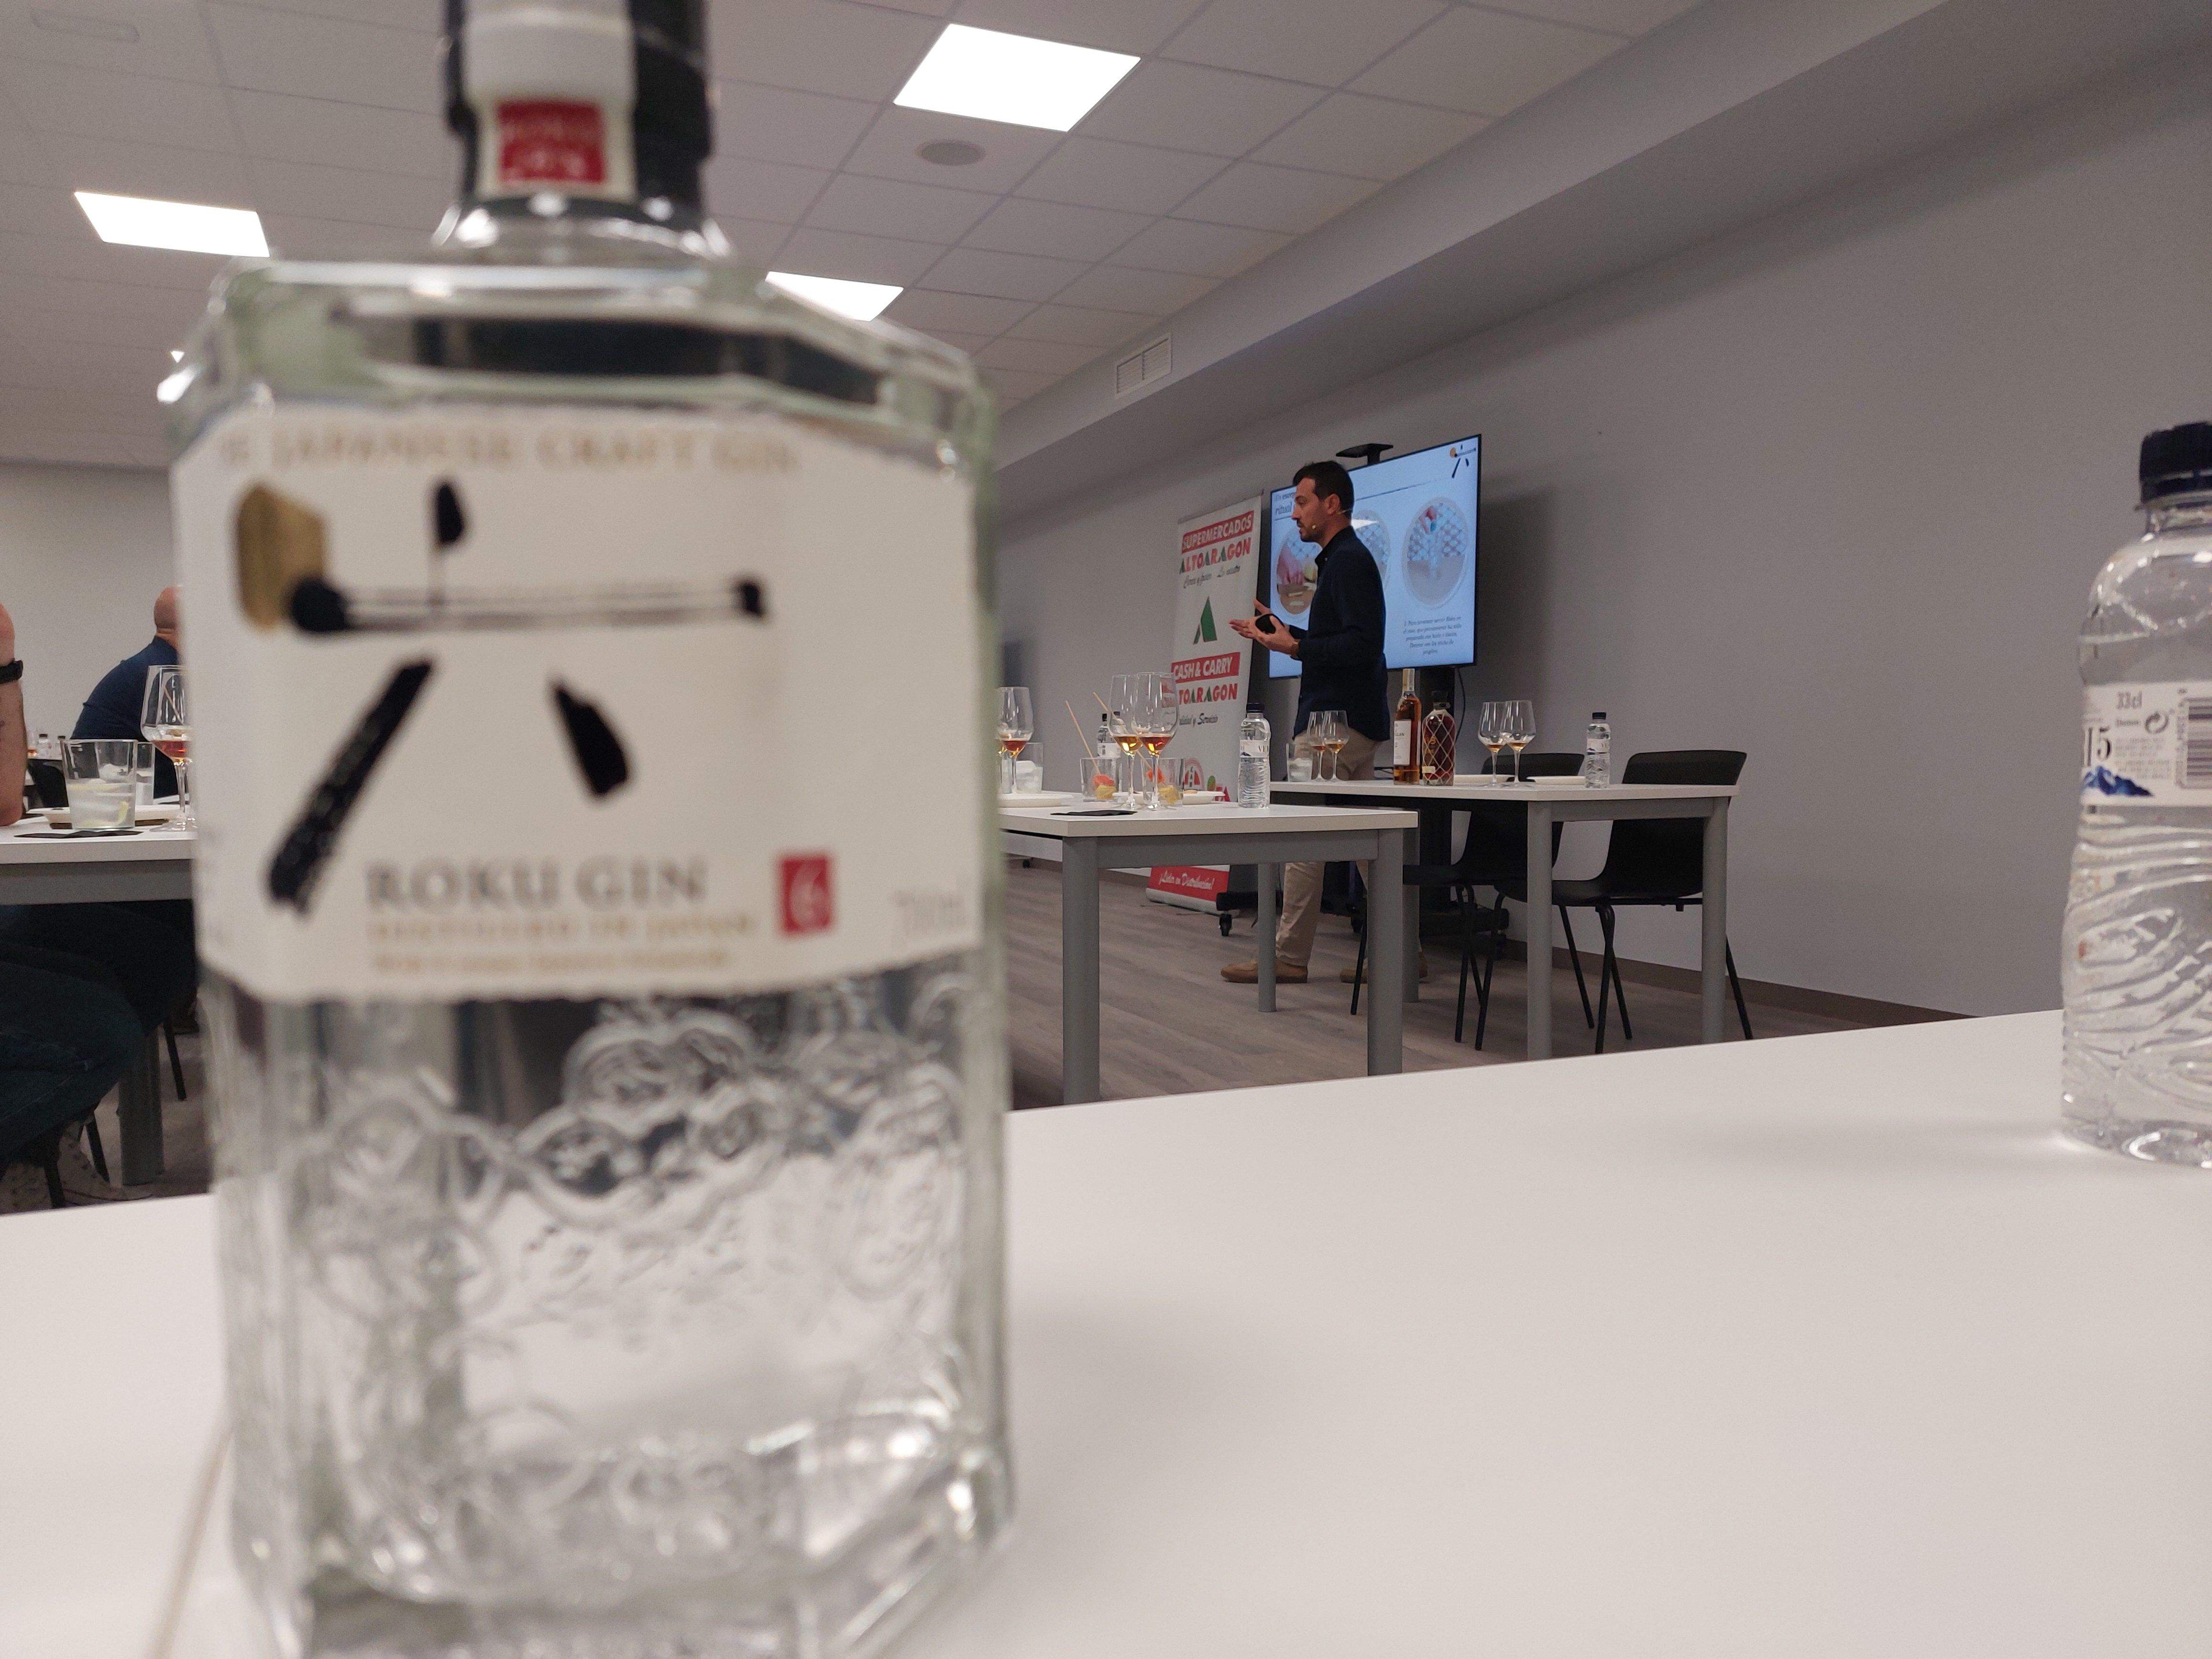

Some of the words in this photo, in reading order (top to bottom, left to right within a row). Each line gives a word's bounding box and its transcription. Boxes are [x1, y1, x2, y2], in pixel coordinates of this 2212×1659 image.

[1183, 514, 1252, 549] SUPERMERCADOS
[1173, 663, 1195, 679] CASH
[1203, 656, 1233, 676] CARRY
[1179, 683, 1238, 705] TOARAGON
[365, 858, 561, 912] ROKU
[574, 855, 708, 907] GIN
